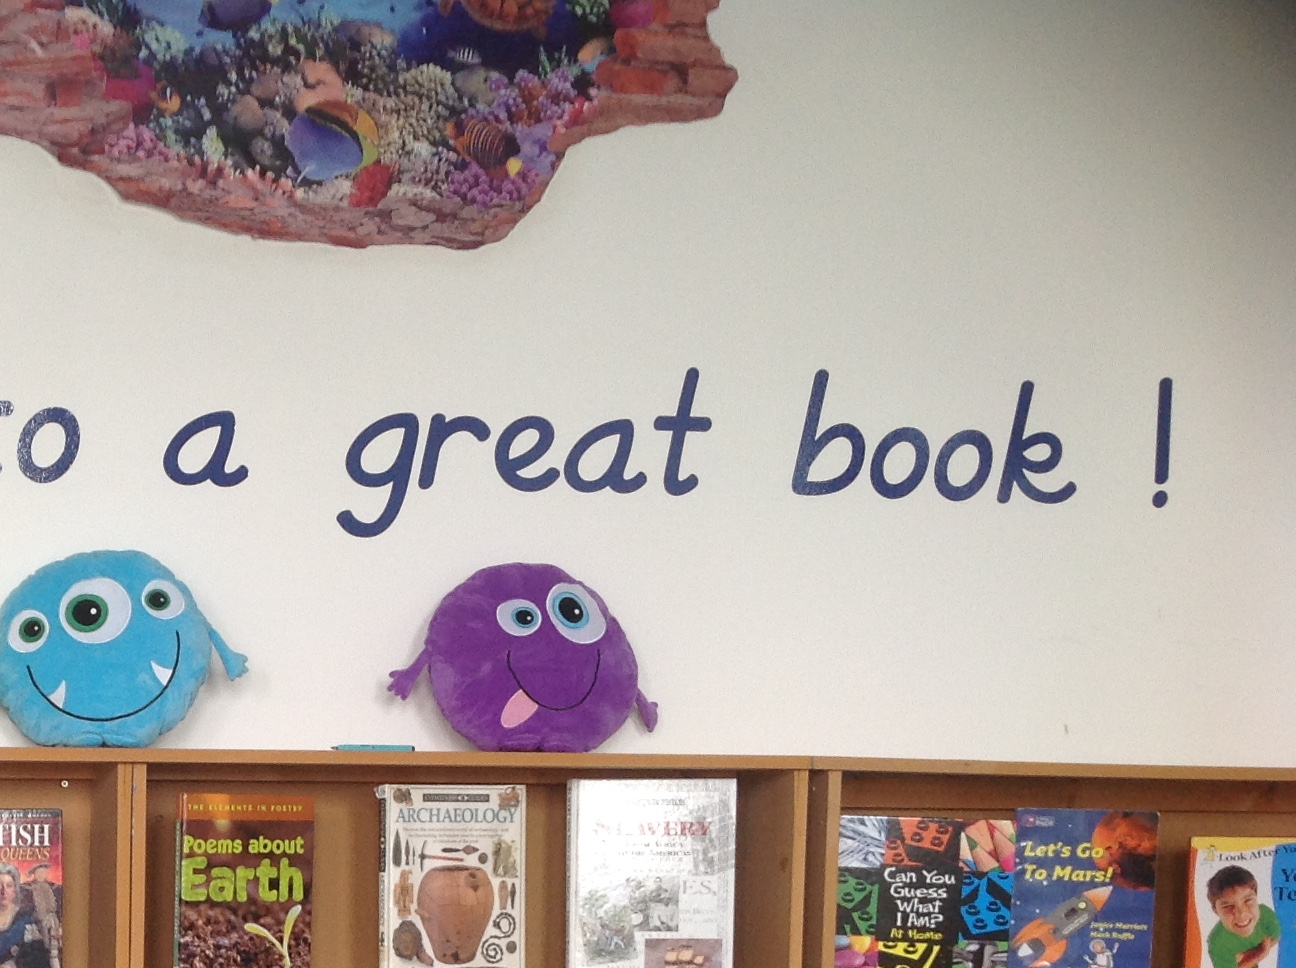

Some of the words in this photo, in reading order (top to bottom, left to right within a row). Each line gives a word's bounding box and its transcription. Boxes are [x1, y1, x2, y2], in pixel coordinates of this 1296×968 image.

[163, 411, 248, 487] a
[336, 367, 712, 538] great
[792, 369, 1076, 505] book
[1151, 377, 1172, 508] !
[395, 808, 516, 823] ARCHAEOLOGY
[595, 821, 713, 837] LAVERY
[184, 835, 242, 854] Poems
[248, 836, 304, 854] about
[1024, 841, 1072, 858] Let's
[1076, 842, 1105, 859] Go
[2, 847, 50, 861] QUEENS
[1218, 853, 1248, 862] Look
[1249, 848, 1279, 860] After
[181, 856, 304, 902] Earth
[884, 867, 916, 883] Can
[922, 870, 956, 885] You
[1024, 864, 1047, 880] To
[1052, 865, 1114, 882] Mars!
[890, 883, 947, 898] Guess
[896, 899, 943, 913] What
[896, 913, 903, 926] I
[907, 913, 944, 928] Am?
